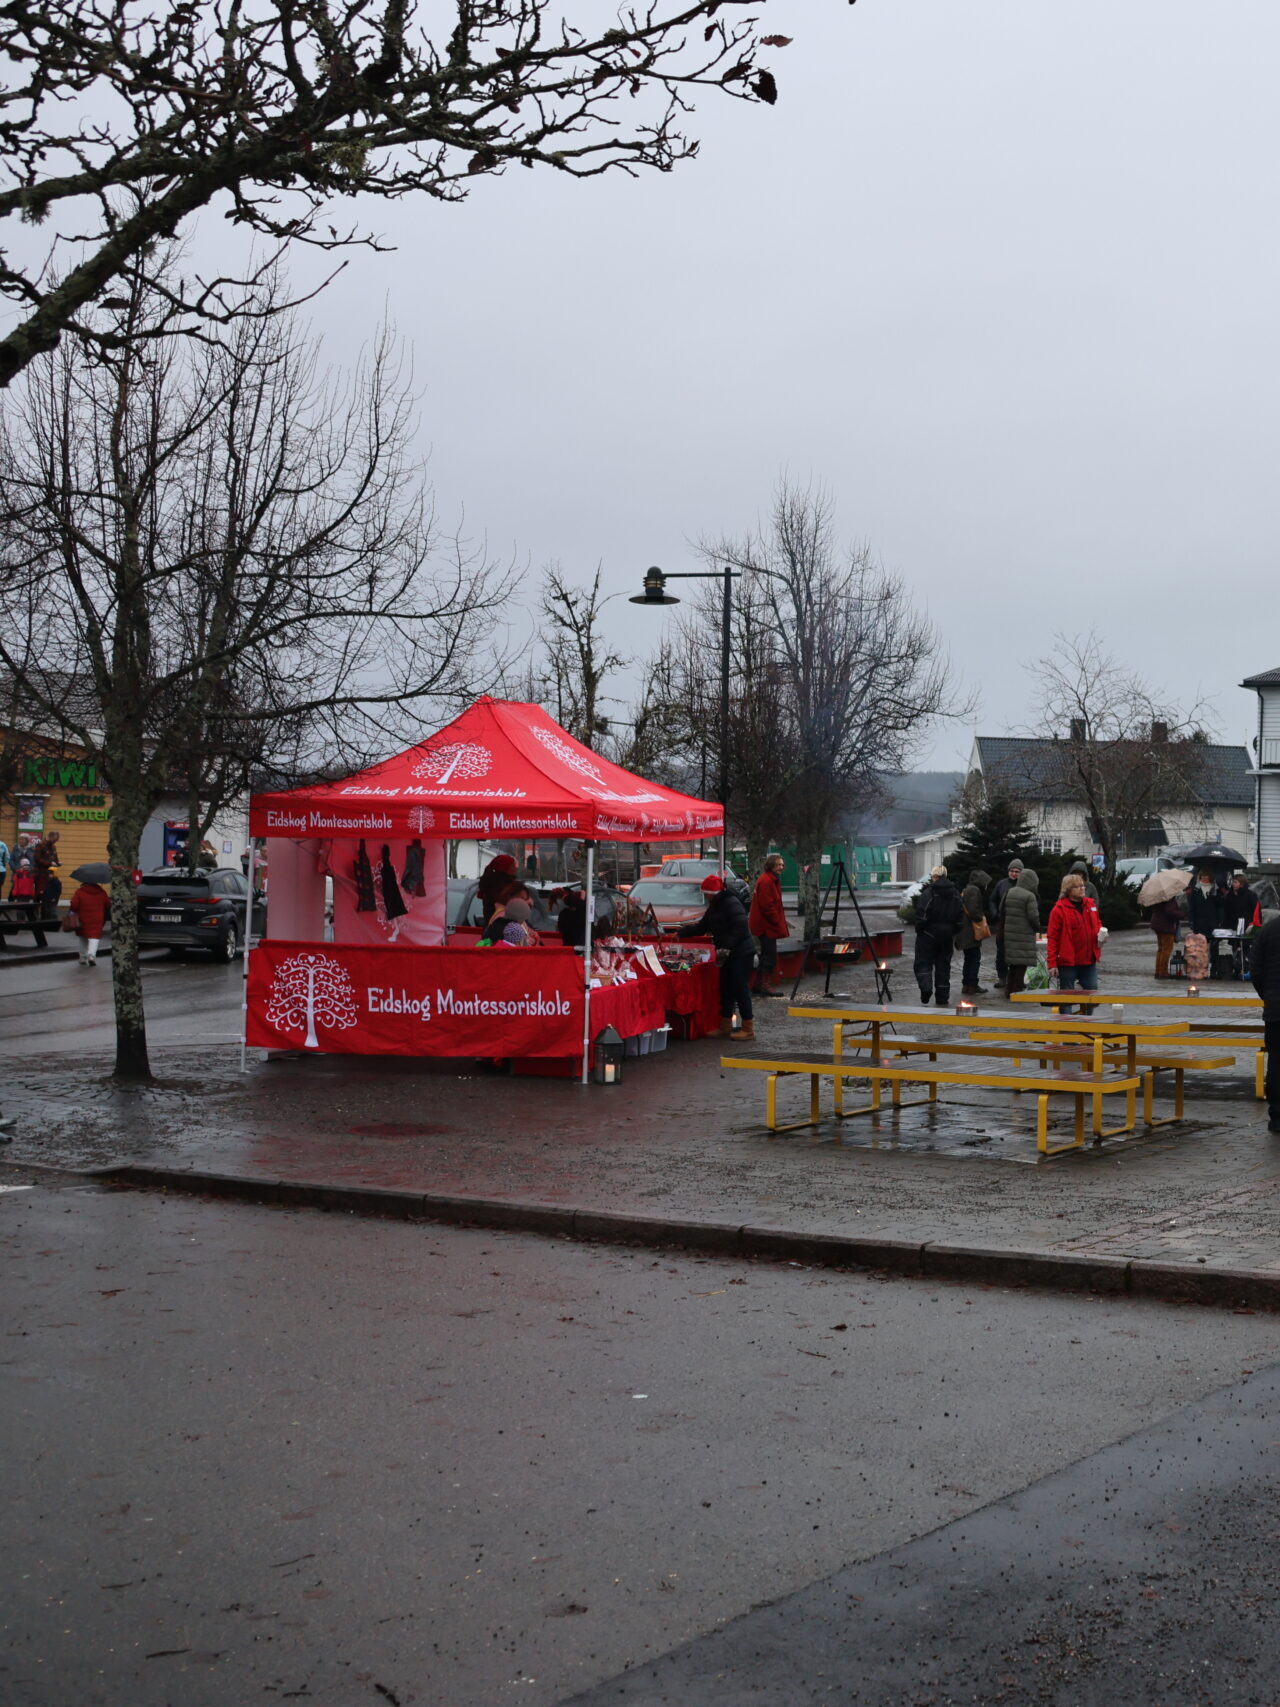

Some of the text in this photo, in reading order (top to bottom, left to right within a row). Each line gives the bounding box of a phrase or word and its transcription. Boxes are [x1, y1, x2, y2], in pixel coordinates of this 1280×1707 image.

[340, 785, 527, 798] Eidskog Montessoriskole
[267, 811, 393, 831] Eidskog Montessoriskole
[449, 812, 489, 832] Eidskog
[493, 812, 577, 829] Montessoriskole
[367, 987, 571, 1021] Eidskog Montessoriskole
